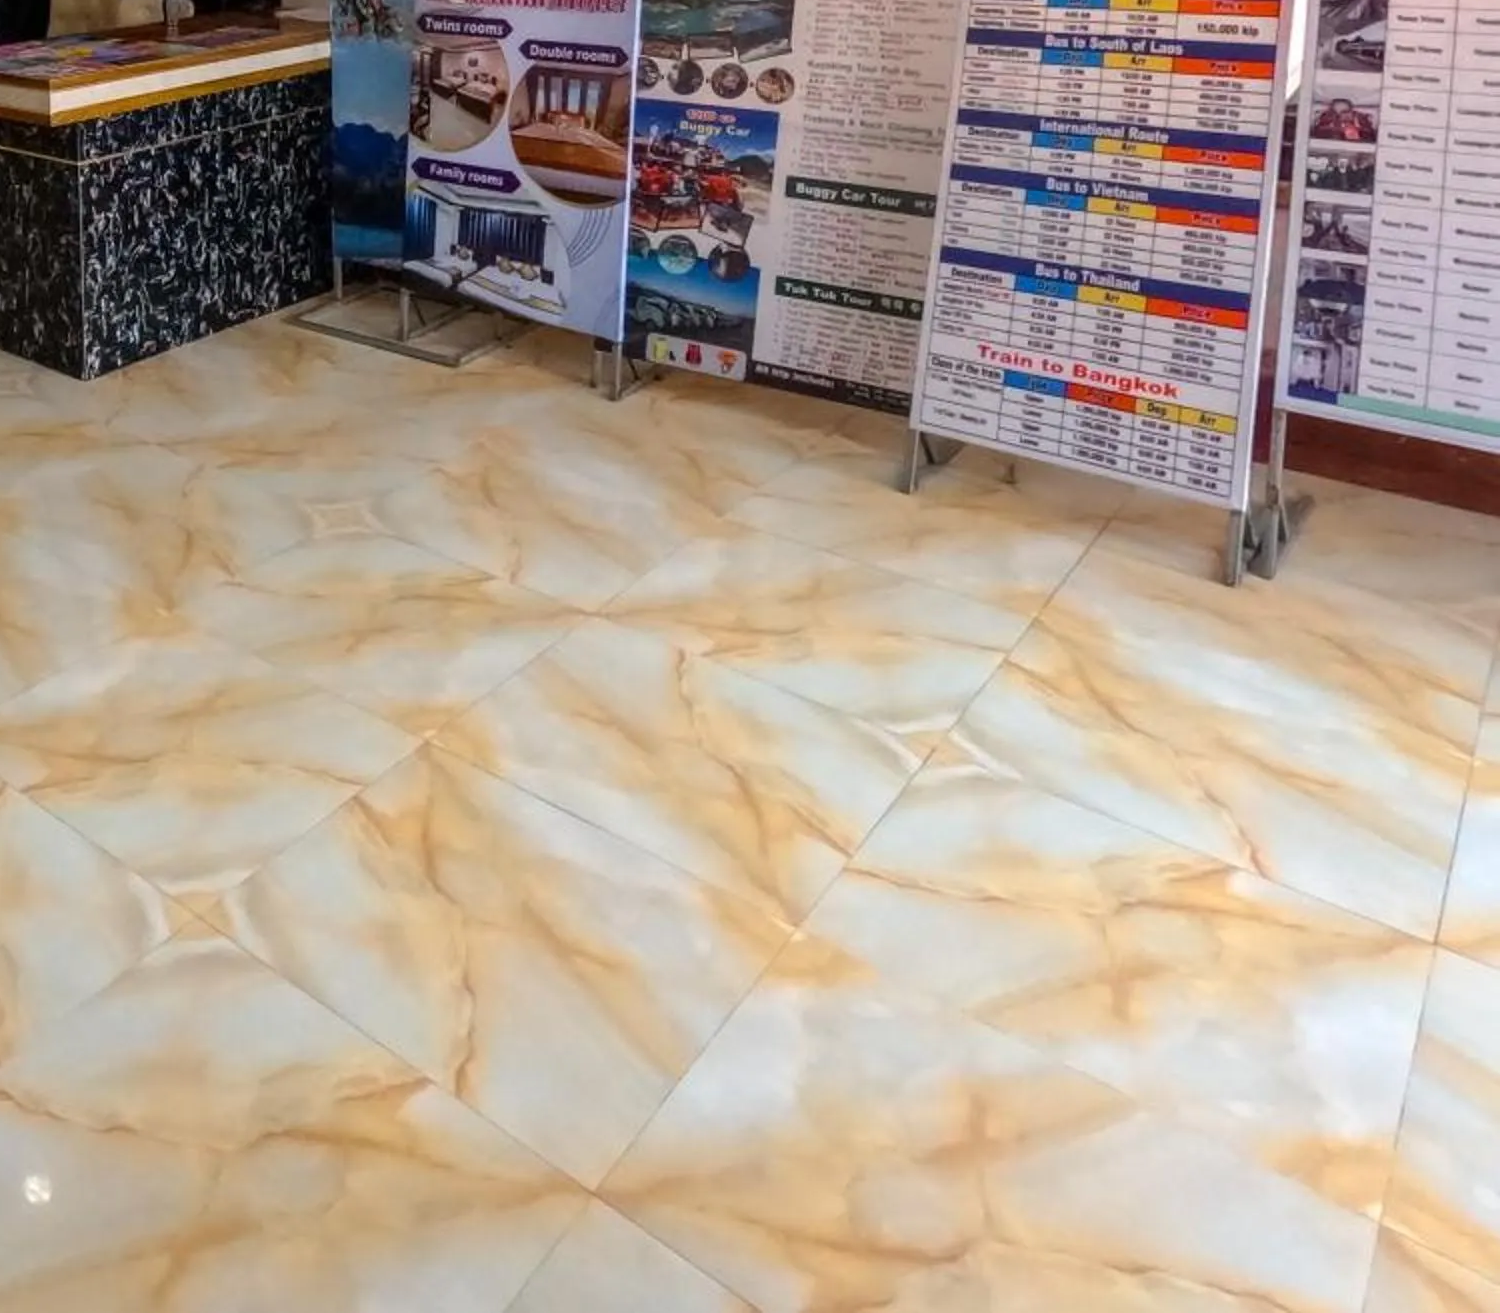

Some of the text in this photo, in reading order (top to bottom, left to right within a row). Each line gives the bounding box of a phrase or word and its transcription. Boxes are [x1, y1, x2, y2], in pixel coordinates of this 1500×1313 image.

[426, 17, 504, 36] Twins rooms
[530, 43, 616, 63] Double rooms
[1045, 34, 1184, 55] Bus to South of Laos
[1040, 118, 1169, 143] International Route
[429, 163, 504, 186] Family rooms
[796, 183, 836, 200] Buggy
[841, 190, 866, 202] Car
[871, 192, 902, 207] Tour
[1046, 176, 1149, 202] Bus to Vietnam
[1035, 262, 1141, 292] Bus to Thailand
[813, 287, 837, 302] Tuk
[842, 292, 872, 307] Tour
[977, 344, 1033, 368] Train
[1041, 358, 1064, 374] to
[1073, 363, 1178, 398] Bangkok
